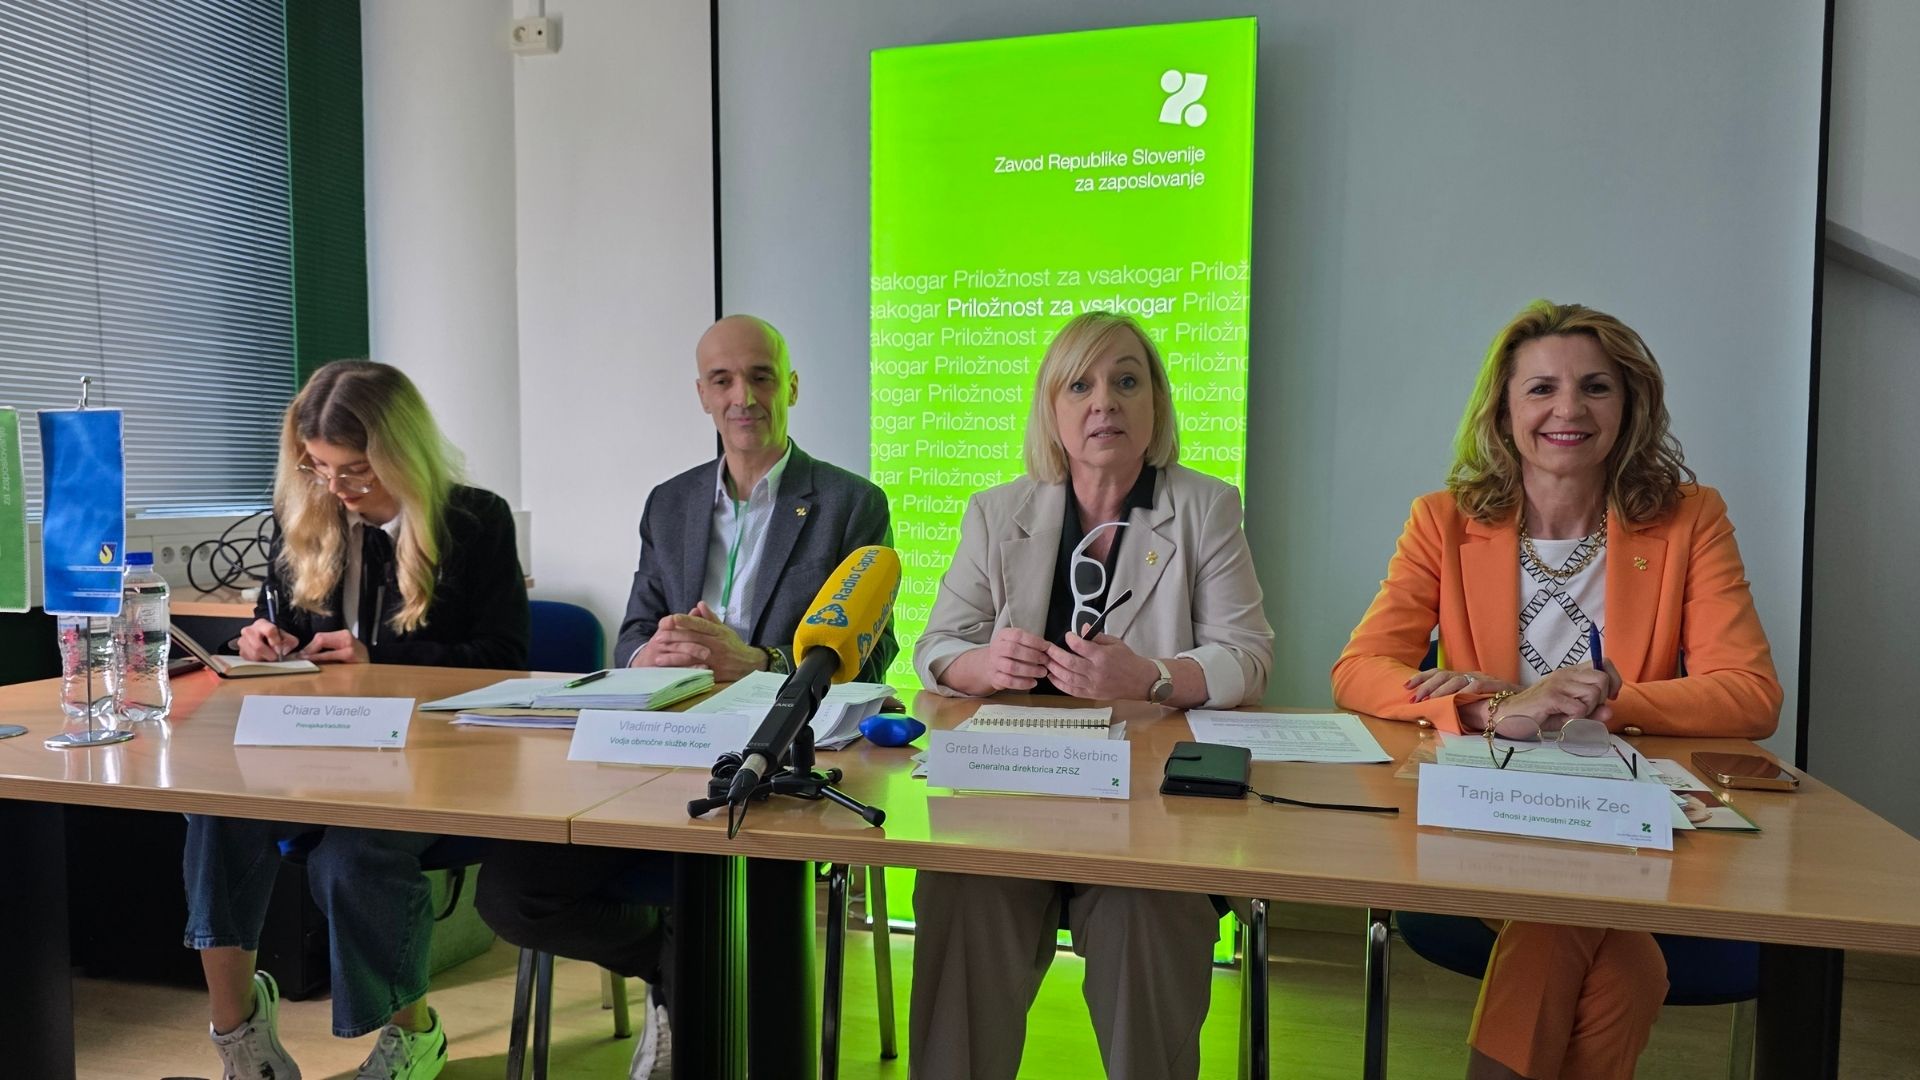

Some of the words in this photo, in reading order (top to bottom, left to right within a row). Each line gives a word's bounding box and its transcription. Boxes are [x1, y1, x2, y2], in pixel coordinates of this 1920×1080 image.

[994, 155, 1044, 173] Zavod
[1048, 151, 1127, 172] Republike
[1132, 146, 1206, 166] Slovenije
[1075, 177, 1095, 192] za
[1098, 169, 1205, 192] zaposlovanje
[953, 268, 1050, 289] Priložnost
[1056, 270, 1081, 287] za
[1087, 265, 1184, 288] vsakogar
[1190, 260, 1249, 282] Prilož
[947, 297, 1044, 318] Priložnost
[1049, 301, 1073, 316] za
[1080, 294, 1177, 318] vsakogar
[941, 326, 1036, 346] Priložnost
[870, 357, 928, 379] kogar
[934, 355, 1030, 375] Priložnost
[928, 383, 1023, 403] Priložnost
[870, 416, 916, 434] ogar
[922, 411, 1016, 431] Priložnost
[915, 439, 1009, 459] Priložnost
[909, 467, 1002, 488] Priložnost
[897, 520, 961, 541] Priložn
[832, 572, 861, 601] Radio
[282, 704, 320, 717] Chiara
[325, 705, 371, 717] Vianello
[619, 720, 660, 732] Vladimir
[610, 736, 630, 746] Vodja
[631, 738, 663, 747] območne
[665, 738, 688, 748] službe
[689, 741, 711, 750] Koper
[945, 742, 979, 755] Greta
[982, 743, 1019, 757] Metka
[1023, 746, 1060, 759] Barbo
[1063, 746, 1118, 763] Škerbinc
[968, 761, 1010, 772] Generalna
[1012, 763, 1054, 774] direktorica
[1055, 766, 1080, 776] ZRSZ
[1457, 784, 1504, 804] Tanja
[1510, 789, 1591, 810] Podobnik
[1596, 798, 1631, 814] Zec
[1493, 810, 1521, 821] Odnosi
[1528, 815, 1567, 826] javnostmi
[1568, 818, 1593, 828] ZRSZ
